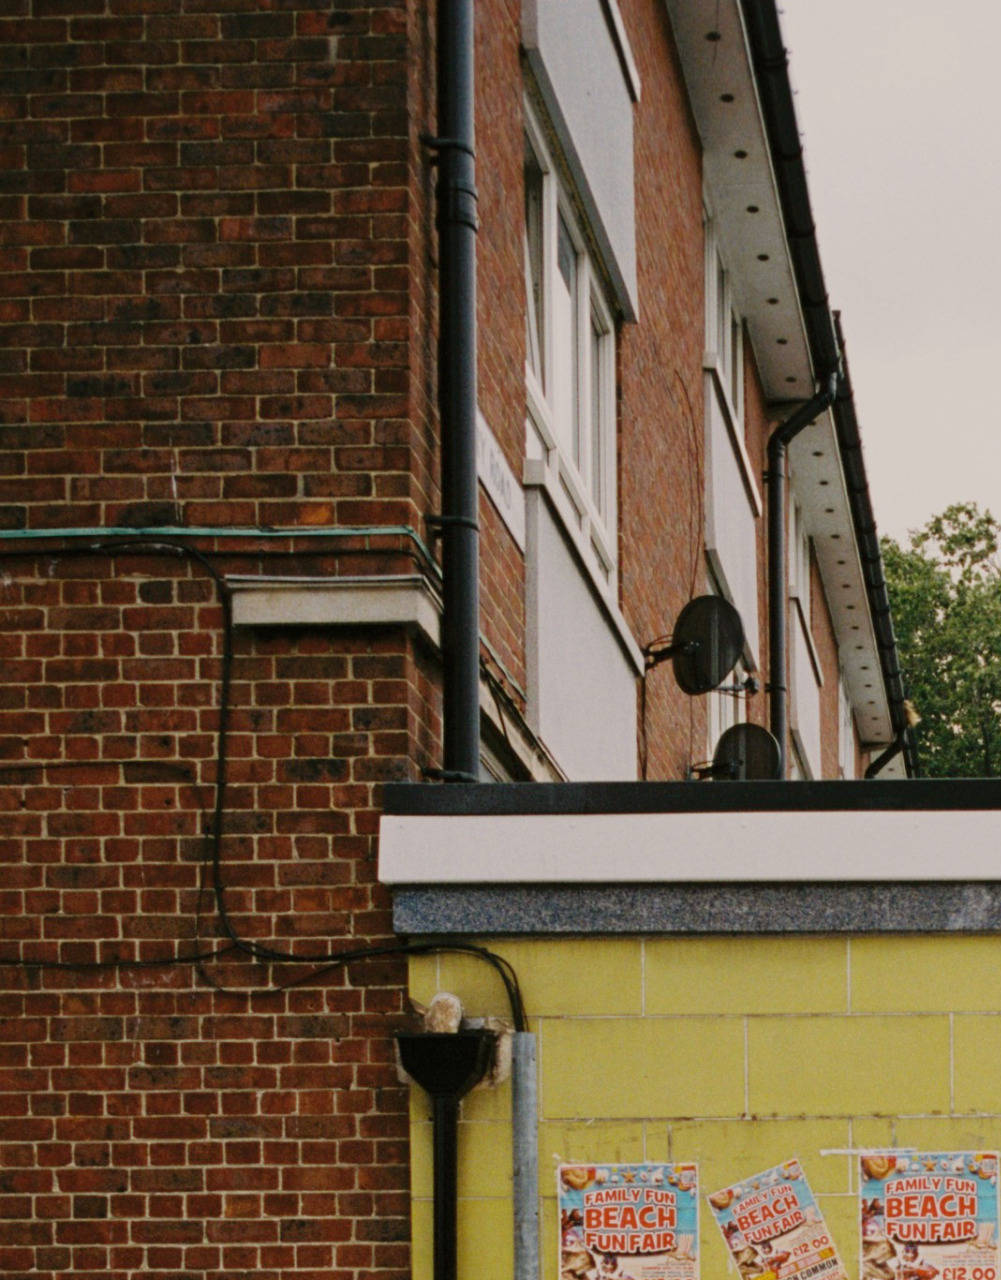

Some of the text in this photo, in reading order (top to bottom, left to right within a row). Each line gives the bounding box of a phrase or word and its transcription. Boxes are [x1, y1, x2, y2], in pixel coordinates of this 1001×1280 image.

[585, 1189, 674, 1204] FAMILY FUN
[886, 1178, 974, 1193] FAMILY FUN
[732, 1184, 792, 1215] FAMILY FUN
[886, 1194, 975, 1218] BEACH
[585, 1206, 674, 1228] BEACH
[736, 1193, 798, 1231] BEACH
[799, 1257, 838, 1280] COMMON
[942, 1267, 995, 1280] £12.00
